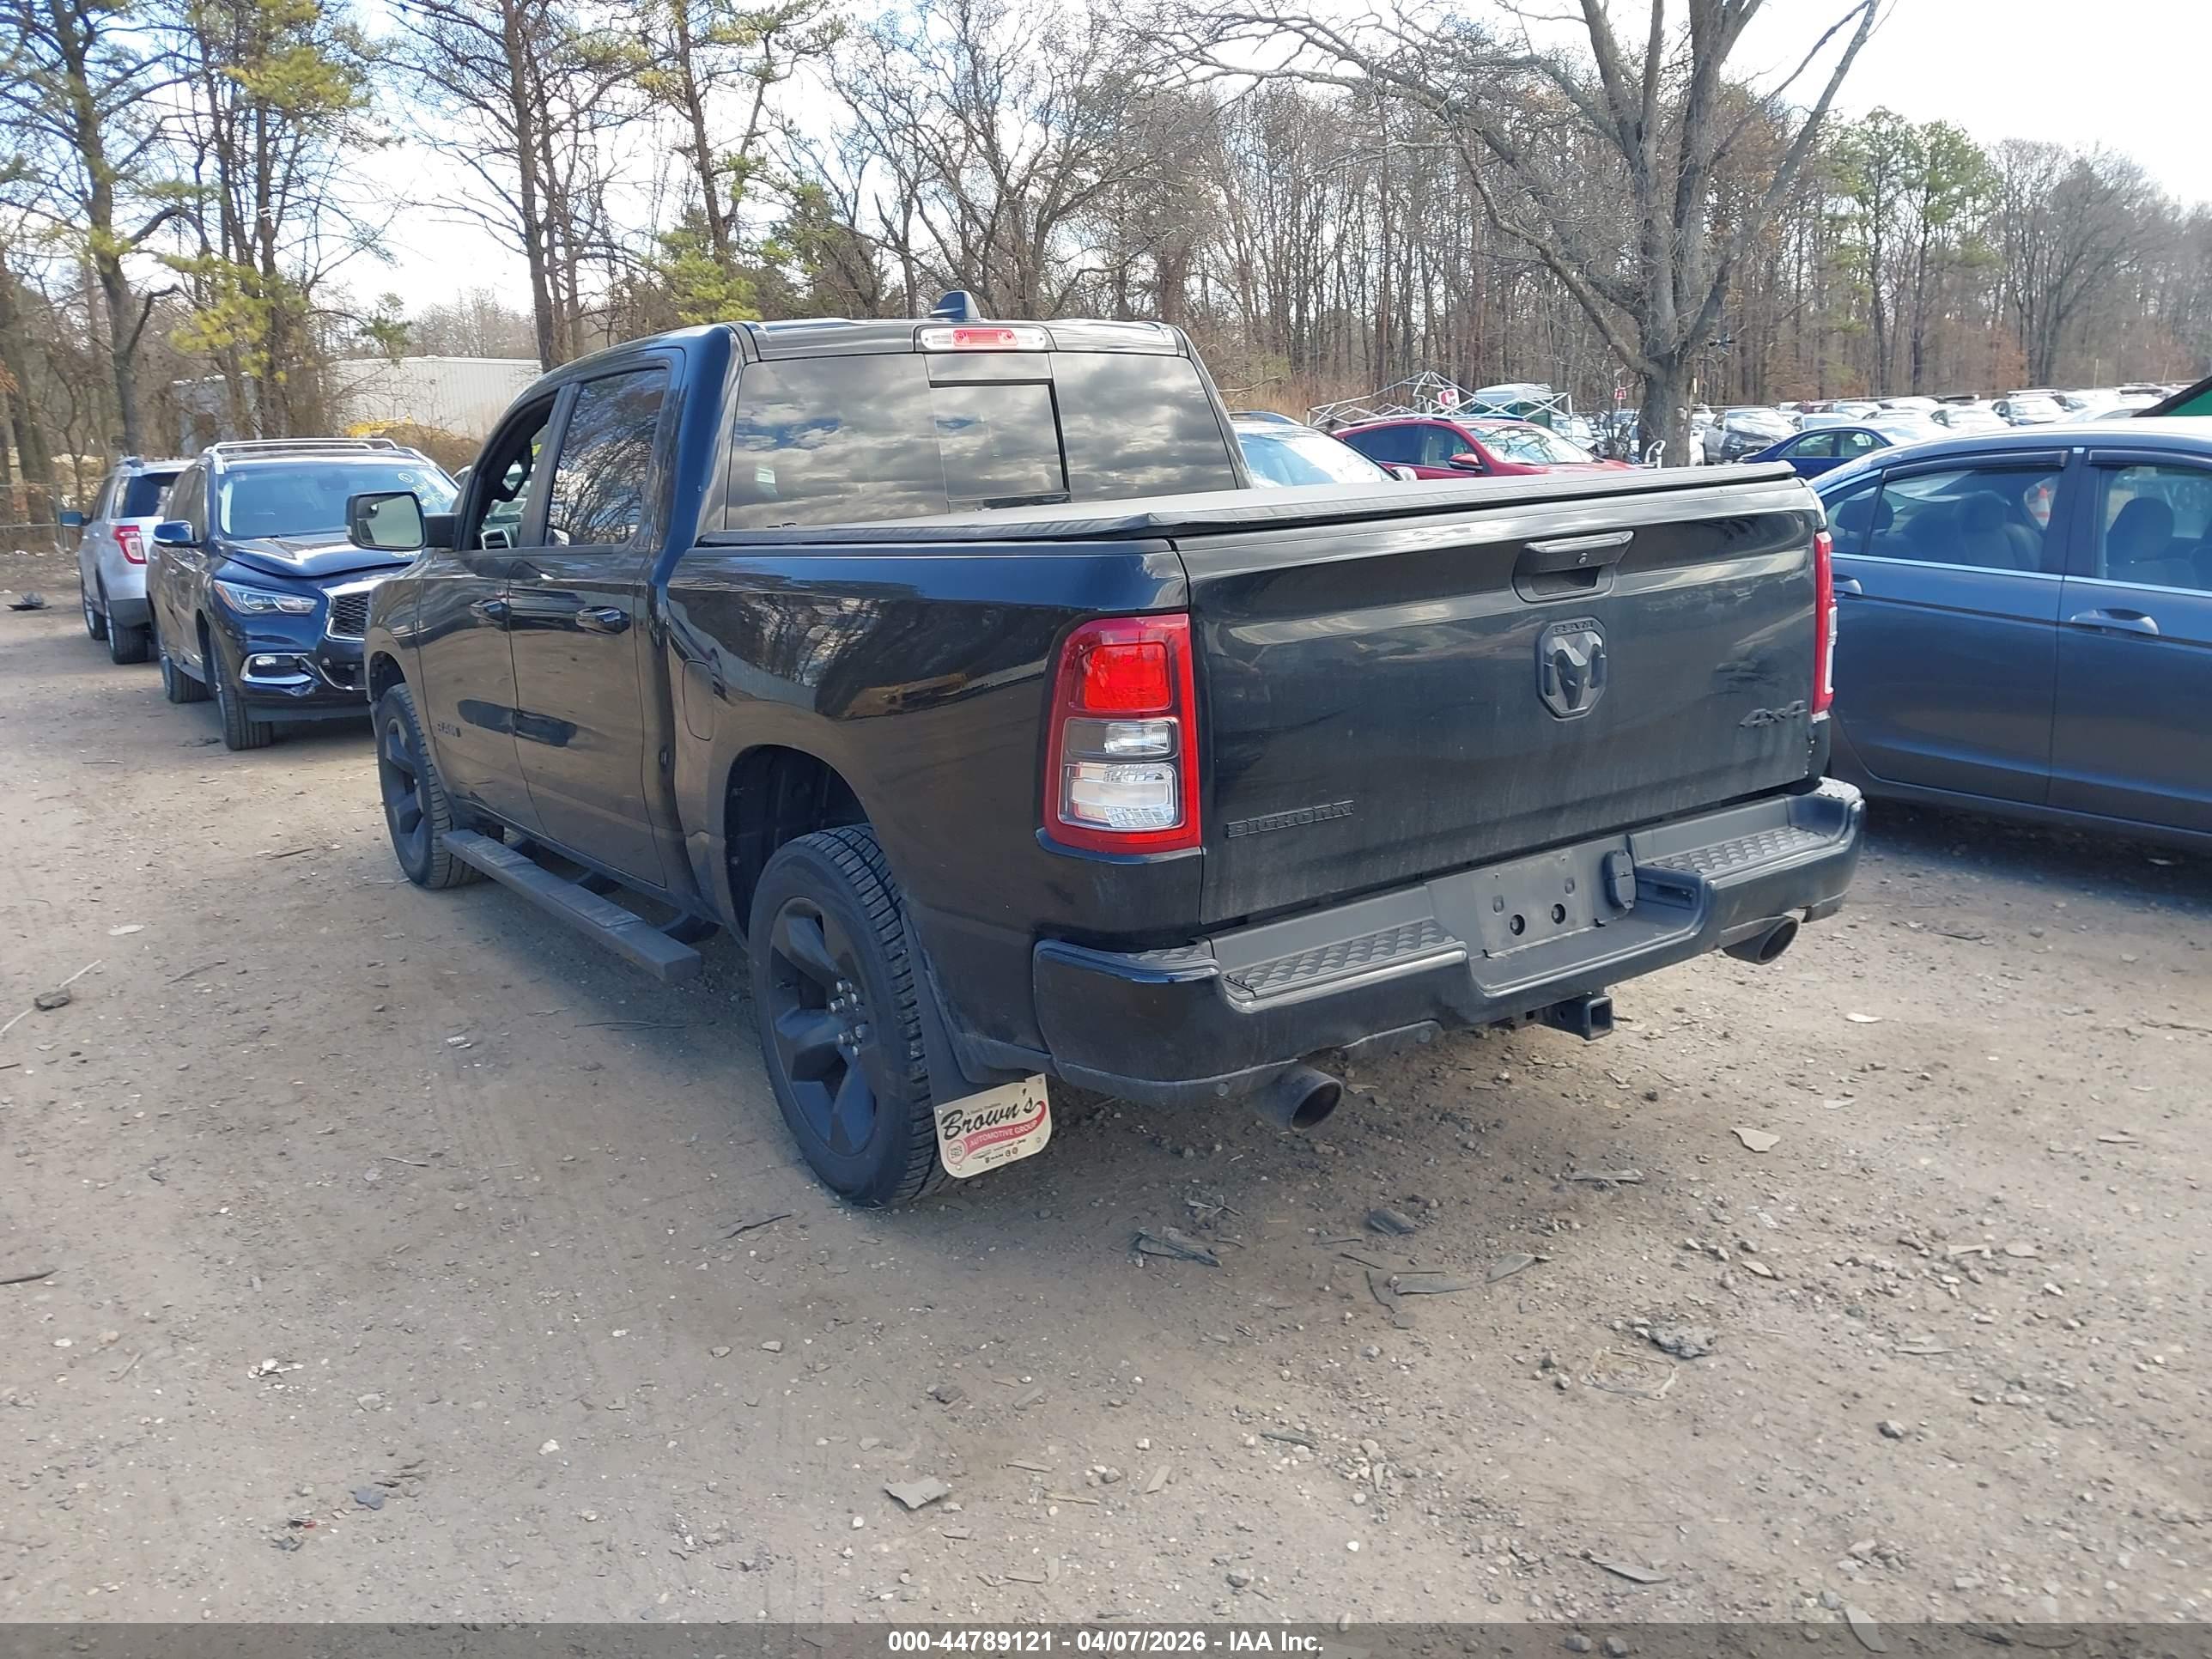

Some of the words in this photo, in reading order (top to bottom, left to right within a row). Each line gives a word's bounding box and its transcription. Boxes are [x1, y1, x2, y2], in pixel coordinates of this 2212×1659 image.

[940, 1088, 1037, 1140] Brown's
[969, 1128, 1013, 1147] AUTOMOTIVE
[1014, 1120, 1038, 1135] GROUP
